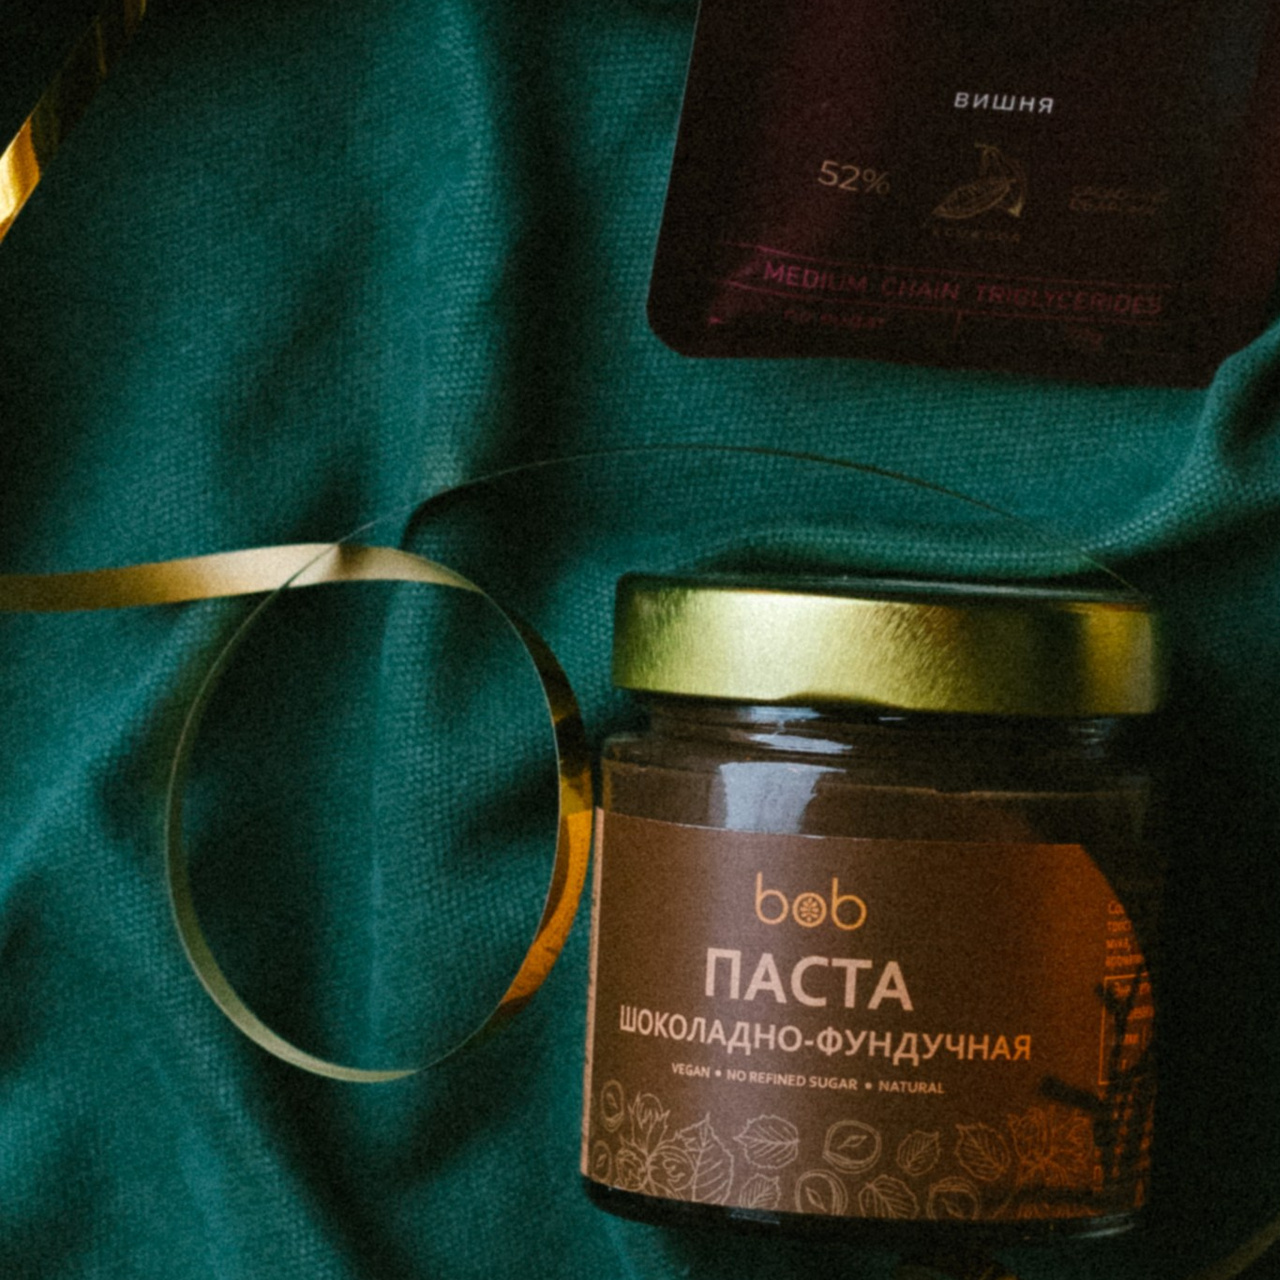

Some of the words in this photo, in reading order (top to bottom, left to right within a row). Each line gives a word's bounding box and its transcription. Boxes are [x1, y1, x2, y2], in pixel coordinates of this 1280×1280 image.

[953, 90, 1056, 116] вишня
[817, 159, 892, 196] 52%
[763, 260, 869, 293] MEDIUM
[880, 276, 961, 302] CHAIN
[754, 871, 868, 931] bob
[704, 947, 914, 1012] ПАСТА
[619, 1004, 1033, 1067] ШОКОЛАДНО-ФУНДУЧНАЯ
[671, 1062, 711, 1079] VEGAN
[726, 1068, 747, 1083] NO
[749, 1070, 807, 1088] REFINED
[809, 1076, 858, 1092] SUGAR
[878, 1079, 946, 1096] NATURAL
